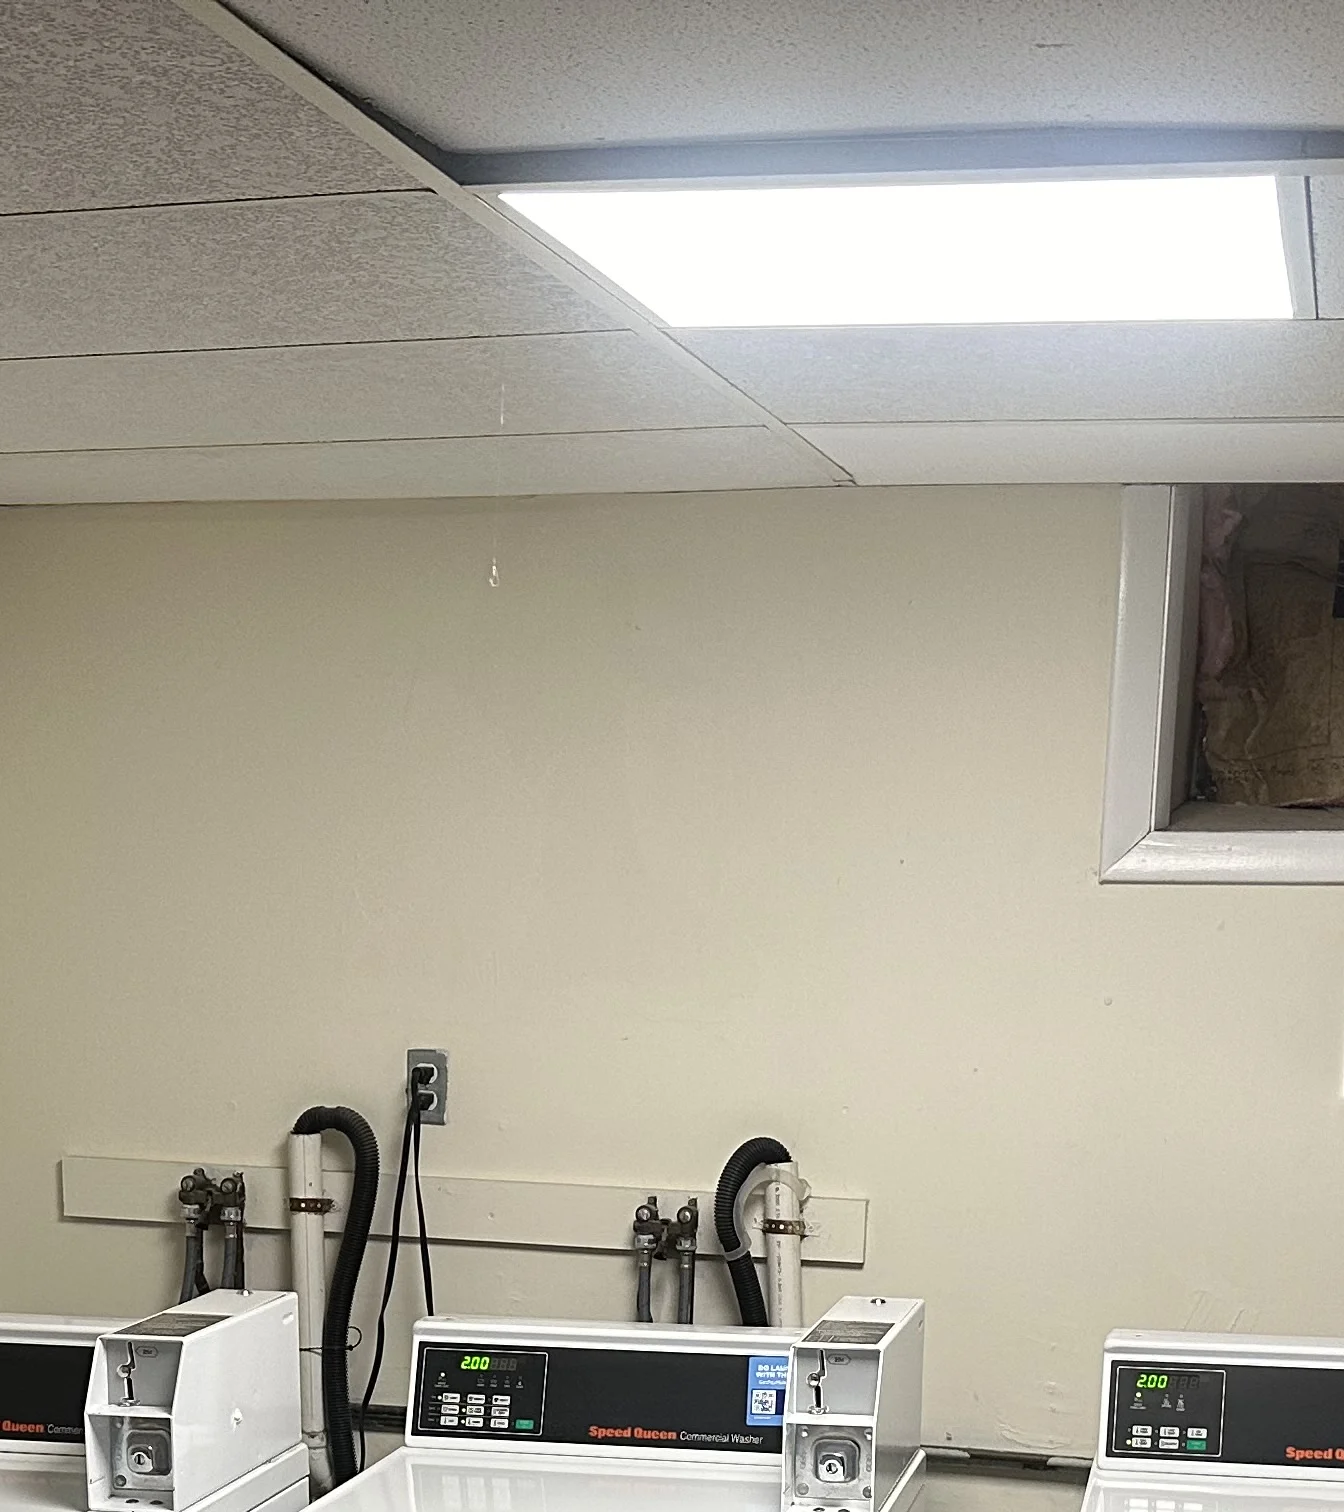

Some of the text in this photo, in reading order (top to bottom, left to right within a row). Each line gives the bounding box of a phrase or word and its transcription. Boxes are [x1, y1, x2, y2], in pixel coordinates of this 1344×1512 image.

[2, 1420, 44, 1434] Queen
[47, 1423, 84, 1436] Commer
[589, 1425, 763, 1444] Speed Queen Commercial Washer
[1286, 1446, 1333, 1460] Speed
